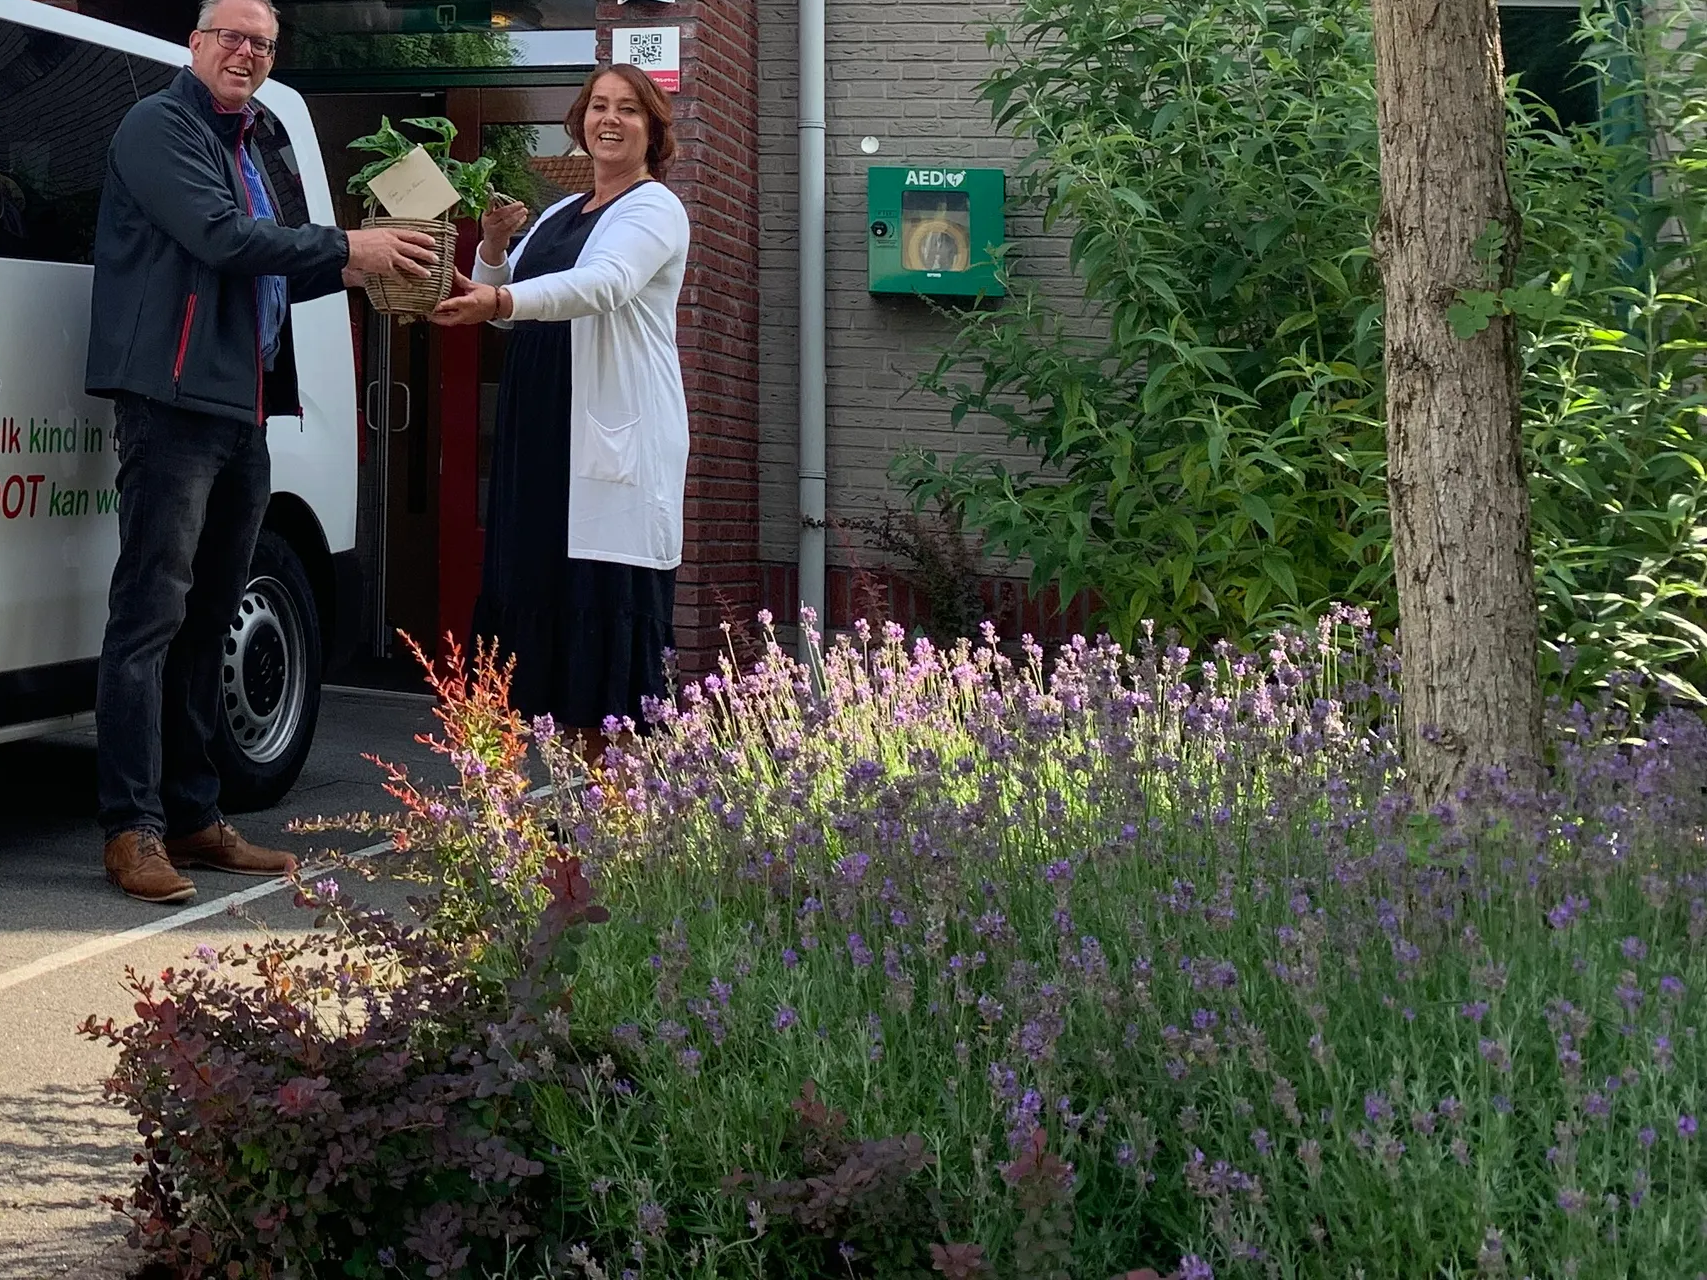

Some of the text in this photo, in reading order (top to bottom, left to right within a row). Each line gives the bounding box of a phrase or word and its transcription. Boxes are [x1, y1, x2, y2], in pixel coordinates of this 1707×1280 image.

[905, 170, 943, 186] AED
[29, 417, 77, 454] kind
[84, 418, 102, 453] in
[49, 482, 89, 517] kan
